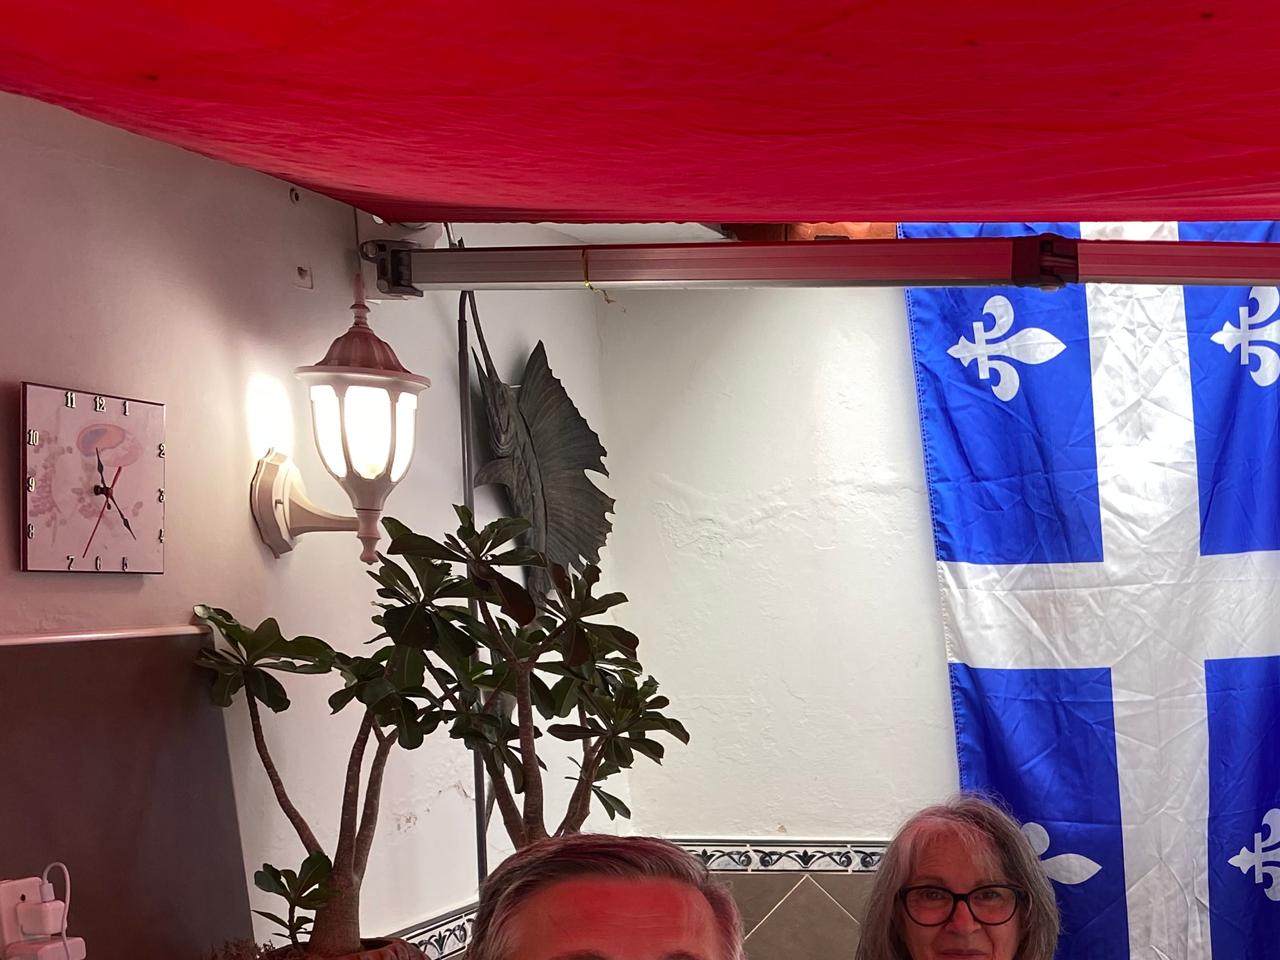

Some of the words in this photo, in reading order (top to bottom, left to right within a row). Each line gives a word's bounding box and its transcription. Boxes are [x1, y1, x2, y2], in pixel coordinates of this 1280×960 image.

[65, 391, 76, 408] 11
[94, 396, 106, 412] 12
[123, 401, 130, 416] 1
[28, 429, 39, 446] 10
[28, 477, 35, 492] 9
[66, 556, 75, 570] 7
